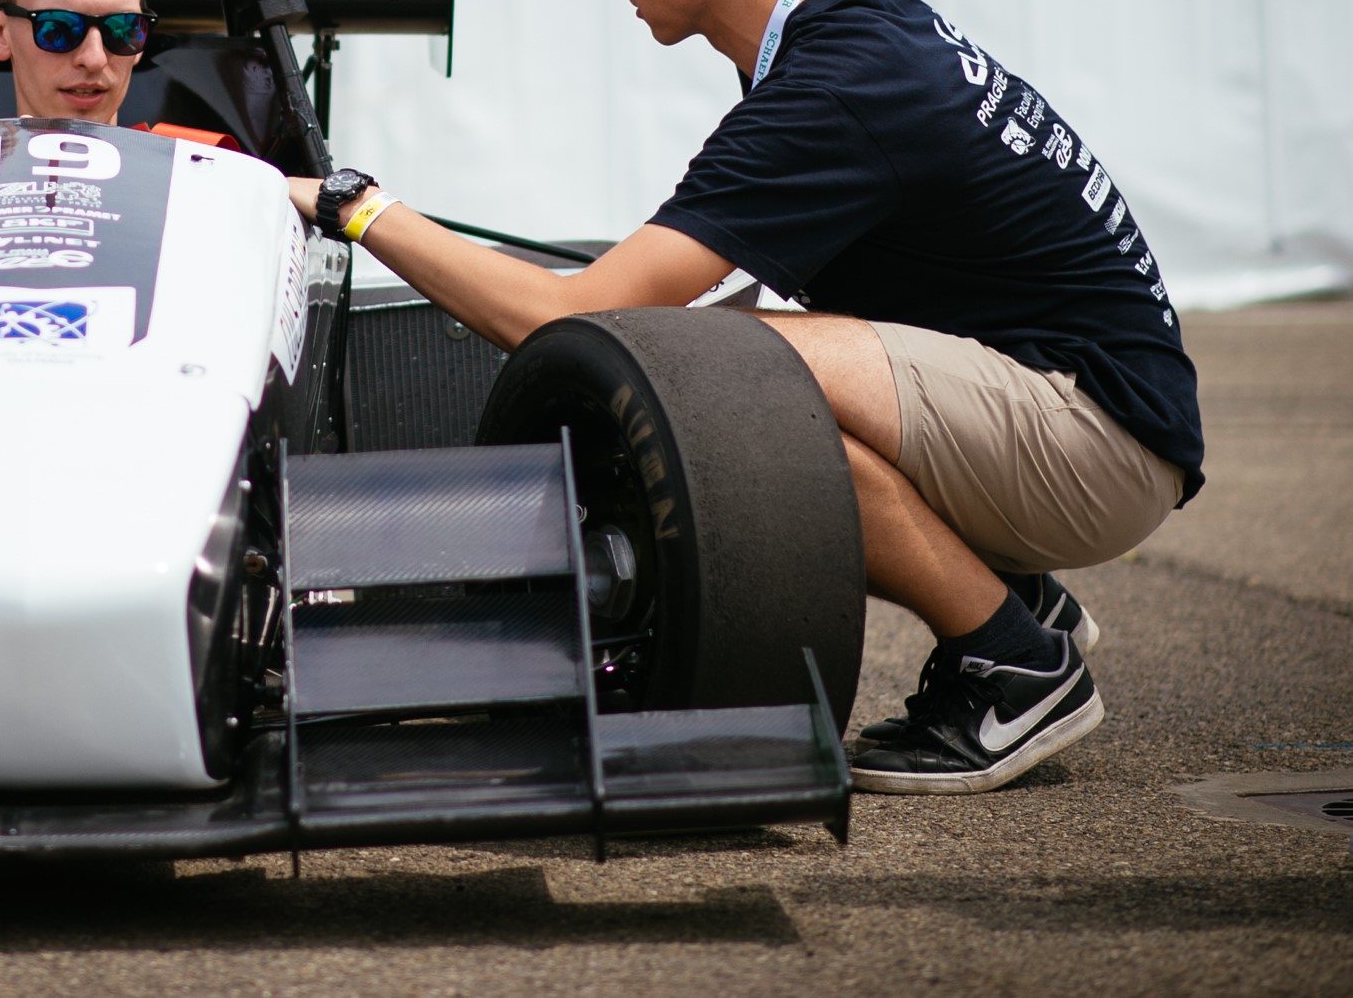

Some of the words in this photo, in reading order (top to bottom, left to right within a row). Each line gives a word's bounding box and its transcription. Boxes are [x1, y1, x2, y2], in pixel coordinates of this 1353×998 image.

[976, 70, 1008, 127] PRAGUE
[1014, 89, 1035, 119] Faculty
[51, 206, 121, 222] PRAMET
[2, 218, 84, 228] SKF
[14, 235, 102, 248] LINET
